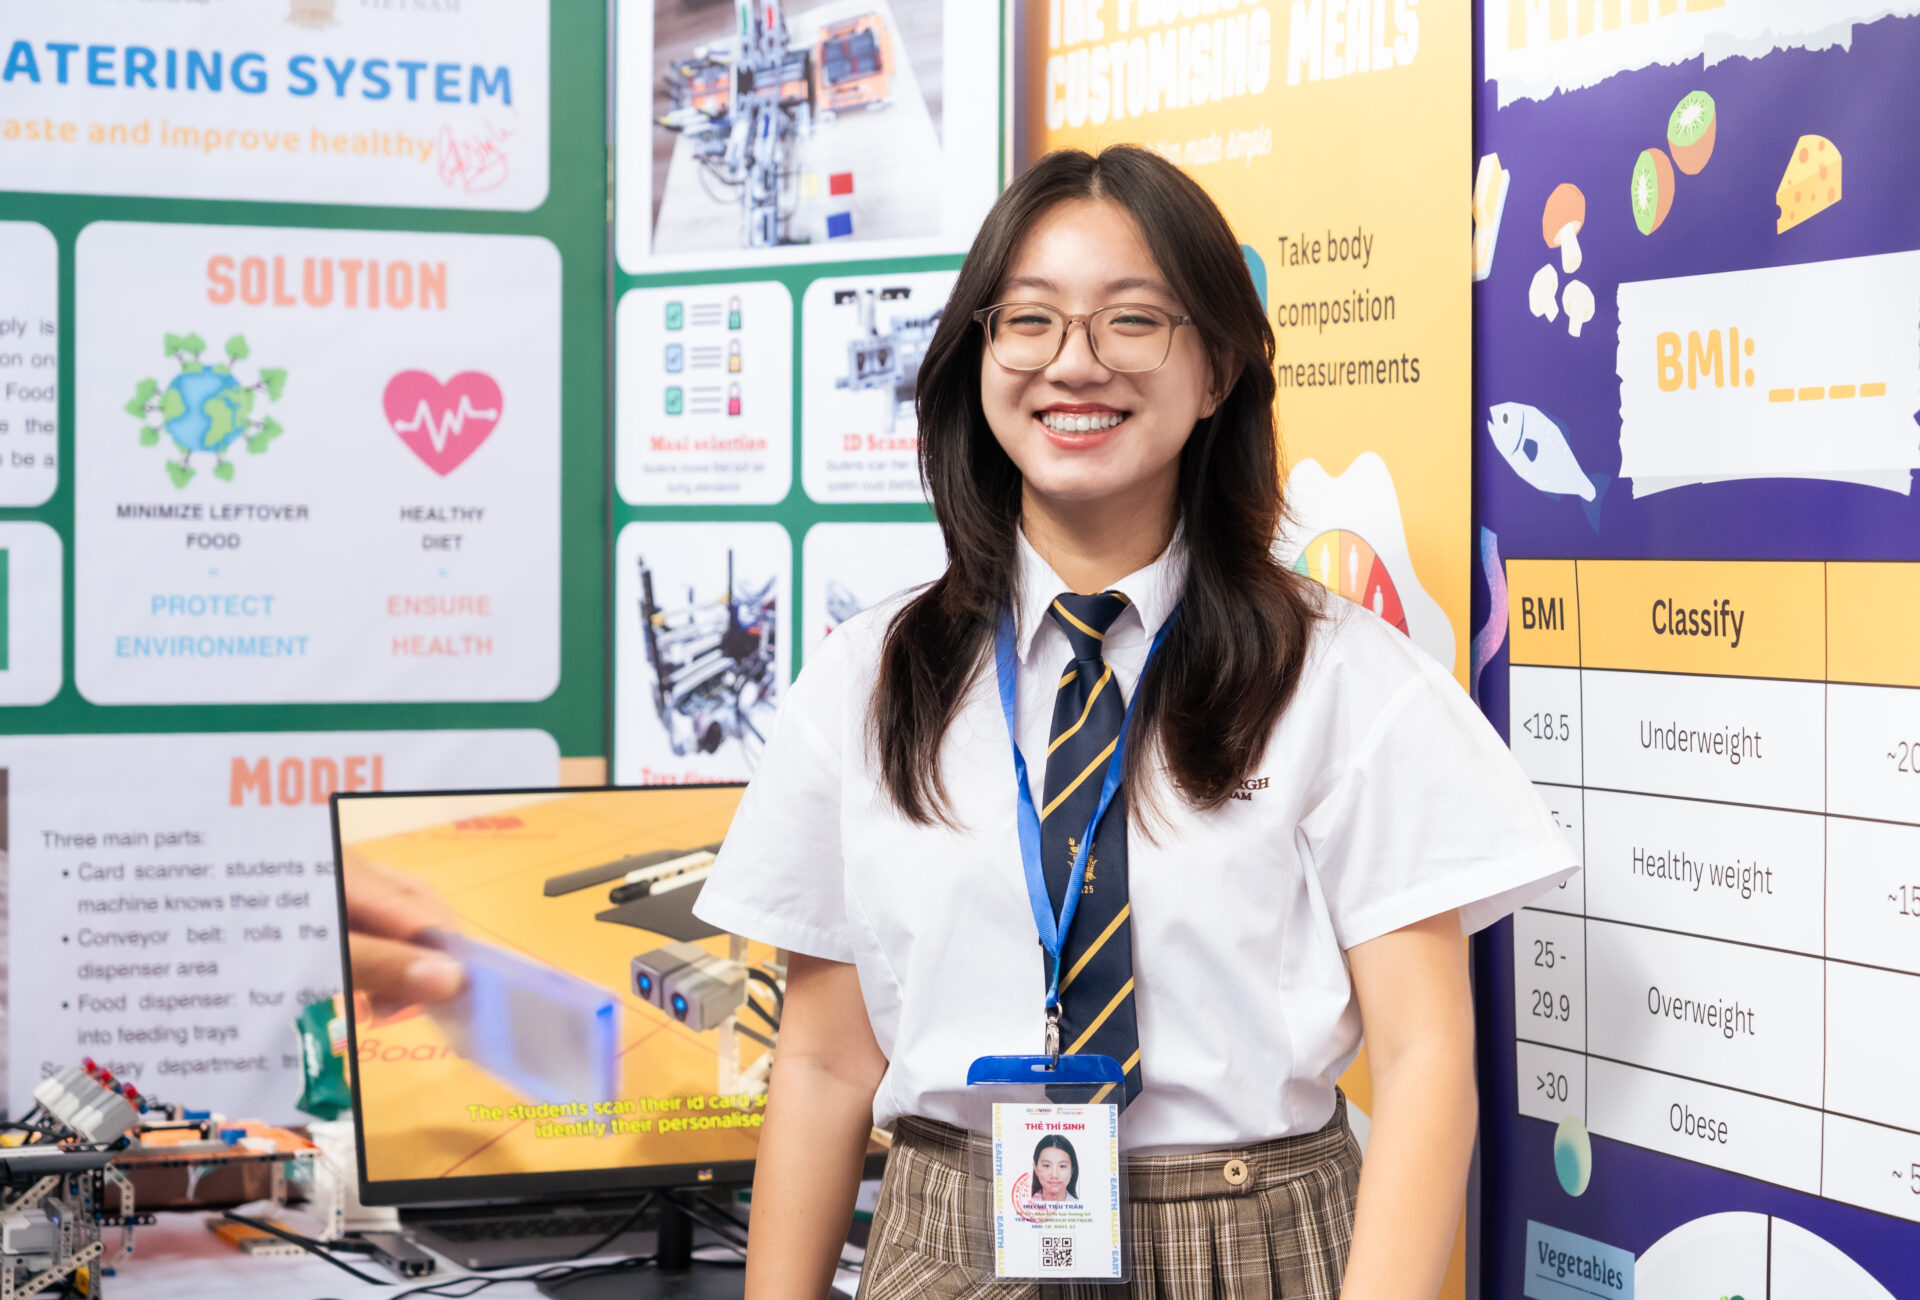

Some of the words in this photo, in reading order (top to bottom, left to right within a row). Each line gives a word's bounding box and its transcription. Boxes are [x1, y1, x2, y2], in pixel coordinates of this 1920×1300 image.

[2, 40, 268, 94] ATERING
[287, 55, 512, 106] SYSTEM
[1045, 7, 1271, 130] CUSTOMISING
[1287, 0, 1419, 85] MEALS
[2, 117, 78, 142] aste
[88, 119, 150, 146] and
[161, 119, 300, 155] improve
[310, 126, 434, 163] healthy
[1278, 232, 1321, 267] Take
[1327, 225, 1373, 269] body
[207, 255, 446, 309] SOLUTION
[1278, 288, 1395, 334] composition
[0, 316, 26, 338] ply
[40, 319, 55, 334] is
[0, 352, 22, 368] on
[31, 353, 55, 368] on
[1278, 353, 1420, 388] measurements
[1656, 326, 1755, 392] BMI:
[6, 382, 55, 400] Food
[26, 418, 55, 434] the
[843, 434, 862, 451] ID
[867, 434, 920, 451] Scann
[12, 451, 34, 466] be
[116, 503, 202, 520] MINIMIZE
[209, 504, 308, 520] LEFTOVER
[400, 506, 484, 522] HEALTHY
[187, 533, 240, 549] FOOD
[422, 535, 462, 550] DIET
[151, 595, 275, 616] PROTECT
[387, 595, 490, 616] ENSURE
[1521, 597, 1565, 631] BMI
[1652, 599, 1745, 648] Classify
[116, 636, 309, 658] ENVIRONMENT
[392, 636, 493, 657] HEALTH
[1523, 713, 1570, 742] <18.5
[1640, 720, 1762, 765] Underweight
[41, 831, 97, 848] Three
[103, 832, 148, 847] main
[154, 831, 205, 850] parts:
[78, 862, 124, 881] Card
[134, 865, 215, 880] scanner:
[225, 860, 304, 877] students
[1632, 846, 1704, 892] Healthy
[1710, 861, 1773, 900] weight
[78, 896, 159, 914] machine
[164, 894, 224, 911] knows
[230, 892, 271, 909] their
[276, 891, 310, 908] diet
[78, 927, 169, 948] Conveyor
[187, 925, 225, 942] belt:
[244, 924, 281, 941] rolls
[299, 923, 328, 940] the
[1534, 940, 1555, 968] 25
[78, 960, 169, 981] dispenser
[176, 961, 218, 976] area
[78, 993, 126, 1012] Food
[139, 991, 236, 1014] dispenser:
[249, 988, 284, 1006] four
[1532, 989, 1570, 1022] 29.9
[1648, 986, 1755, 1039] Overweight
[78, 1027, 112, 1045] into
[117, 1024, 188, 1045] feeding
[193, 1023, 239, 1042] trays
[157, 1055, 269, 1078] department:
[1536, 1072, 1568, 1102] >30
[466, 1104, 503, 1121] The
[508, 1102, 588, 1120] students
[593, 1100, 636, 1115] scan
[640, 1096, 682, 1112] their
[686, 1094, 705, 1110] id
[708, 1092, 750, 1110] card
[536, 1119, 606, 1138] identify
[611, 1117, 652, 1134] their
[1045, 1121, 1061, 1131] THÍ
[1062, 1123, 1085, 1131] SINH
[1670, 1103, 1728, 1145] Obese
[995, 1143, 1003, 1177] EARTH
[1110, 1177, 1118, 1211] EARTH
[1538, 1239, 1623, 1291] Vegetables
